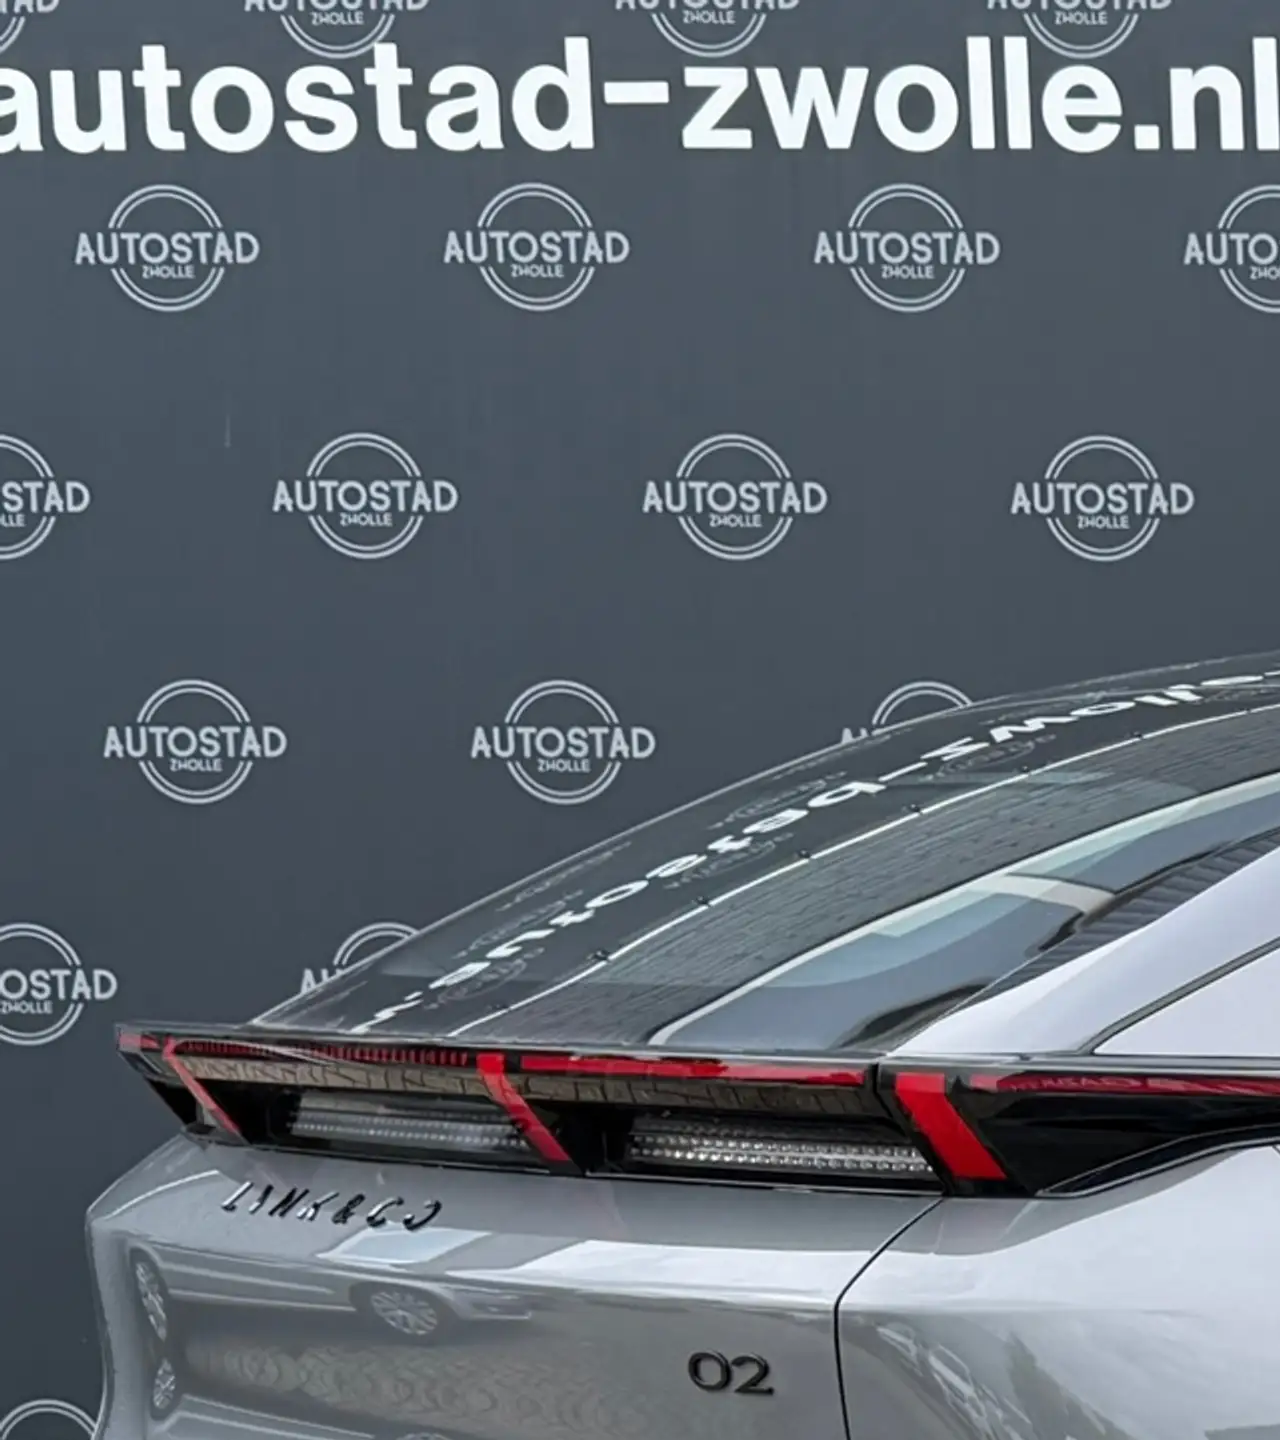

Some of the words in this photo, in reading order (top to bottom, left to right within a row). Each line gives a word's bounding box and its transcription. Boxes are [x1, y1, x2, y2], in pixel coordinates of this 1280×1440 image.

[0, 36, 1280, 153] autostad-zwolle.nl
[75, 231, 260, 265] AUTOSTAD
[443, 230, 630, 264] AUTOSTAD
[814, 231, 1000, 265] AUTOSTAD
[272, 480, 458, 513] AUTOSTAD
[642, 480, 828, 513] AUTOSTAD
[1011, 482, 1195, 515] AUTOSTAD
[103, 726, 287, 758] AUTOSTAD
[471, 726, 656, 759] AUTOSTAD
